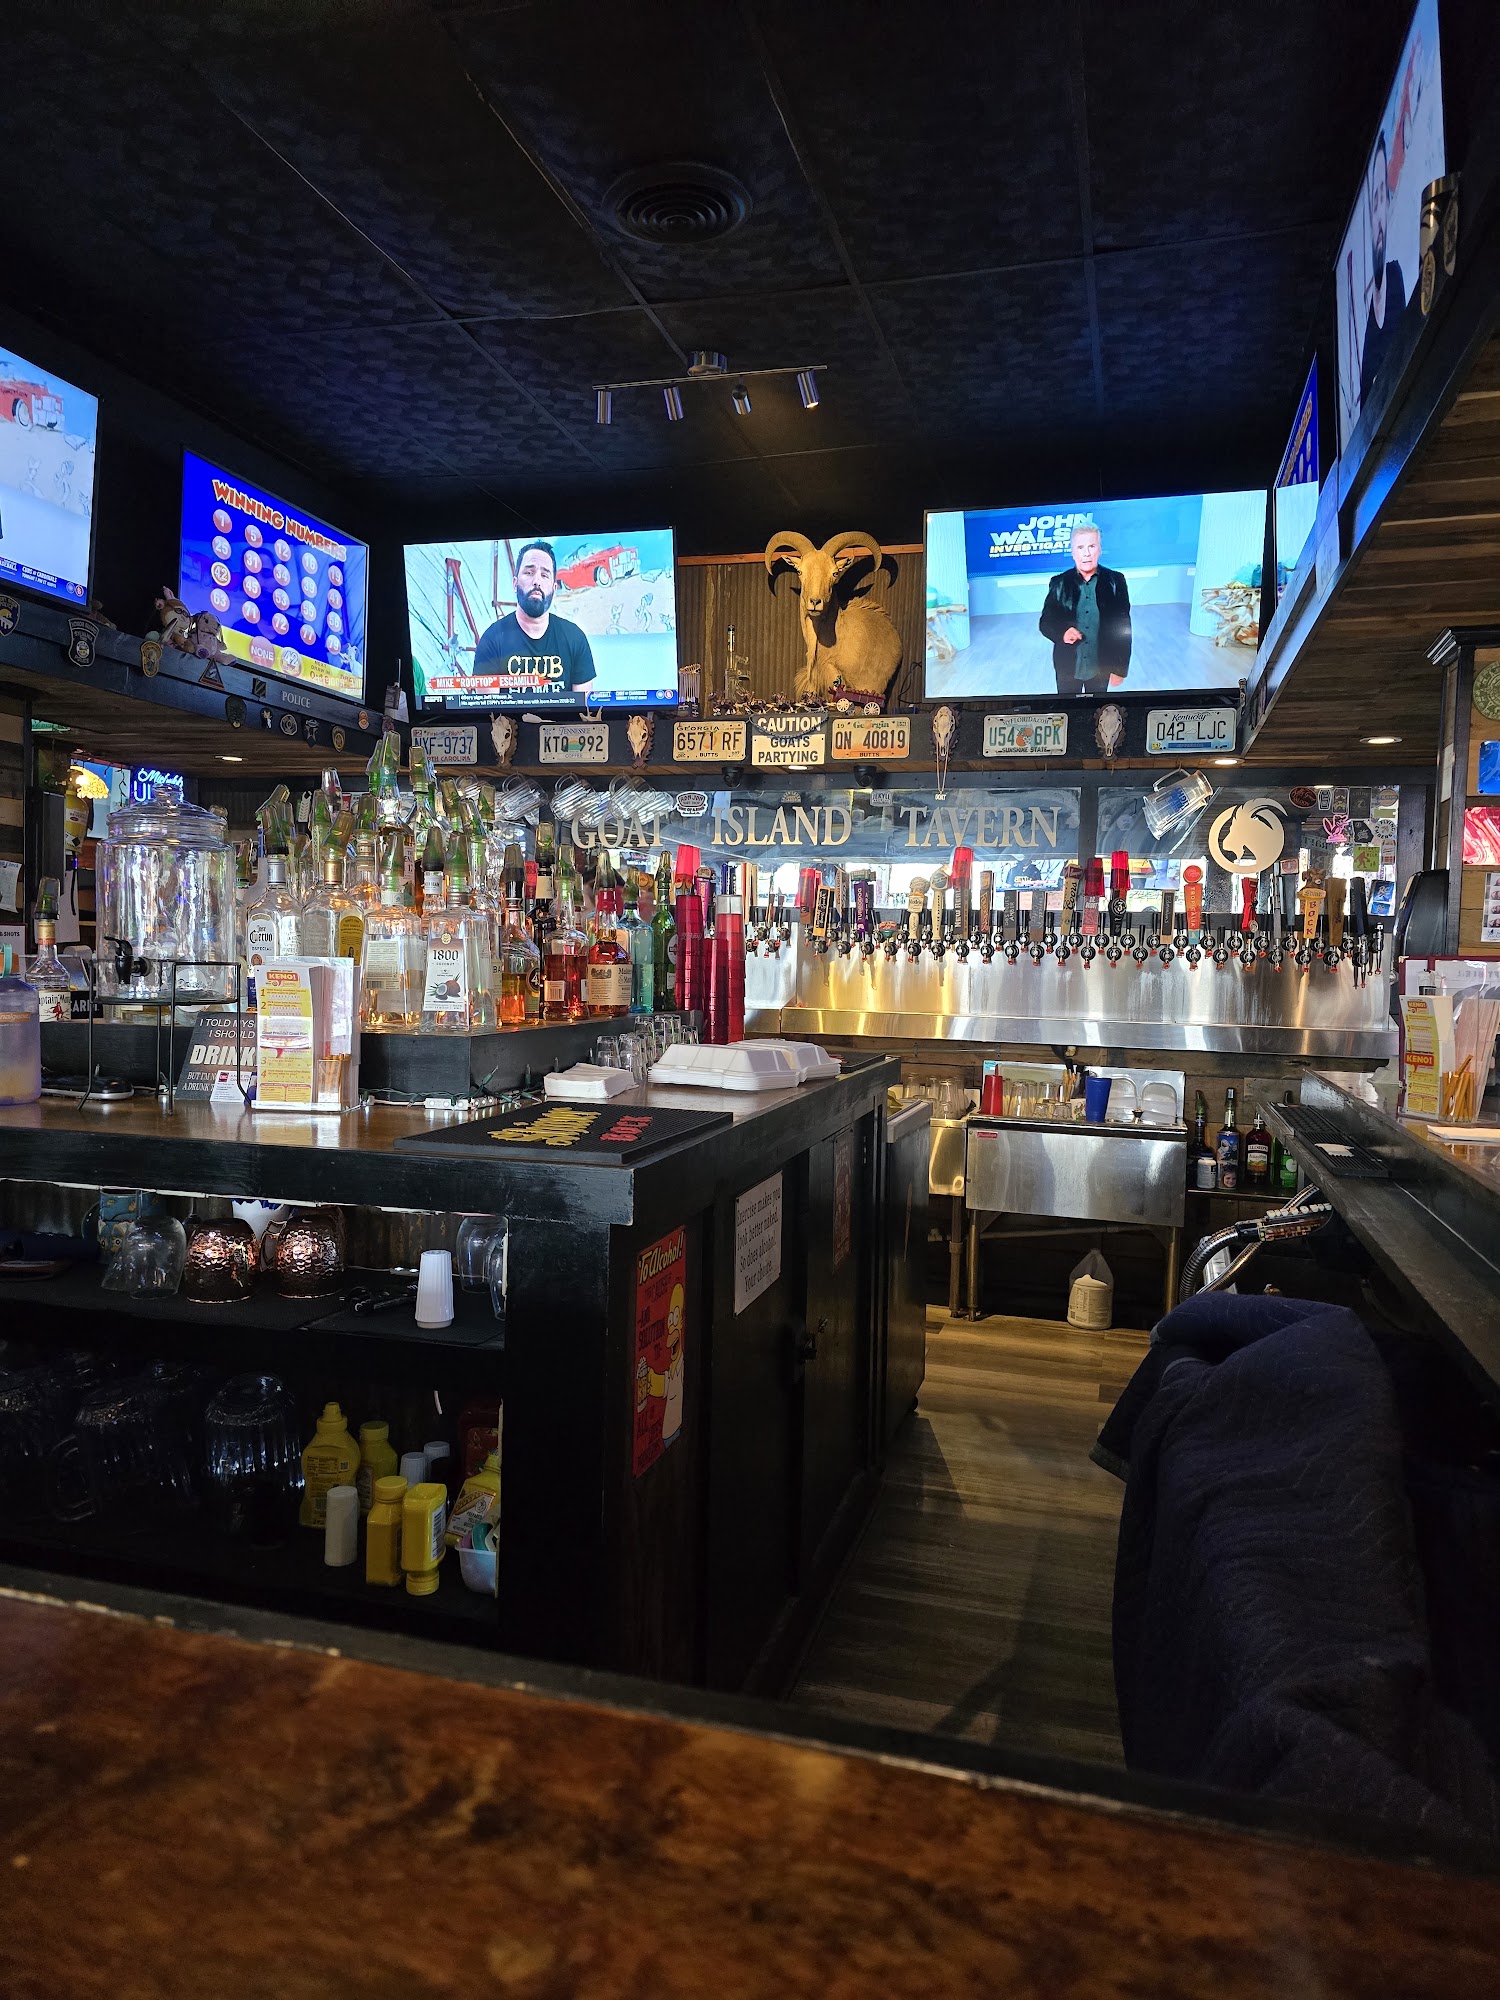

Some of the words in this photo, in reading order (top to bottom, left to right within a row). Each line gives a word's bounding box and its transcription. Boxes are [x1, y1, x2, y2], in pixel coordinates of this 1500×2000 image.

[212, 479, 284, 530] WINNING
[285, 515, 347, 562] NUMBERS
[1018, 513, 1094, 530] JOHN
[276, 545, 289, 558] 12
[304, 558, 316, 570] 16
[330, 570, 342, 582] 19
[216, 542, 228, 554] 25
[246, 556, 258, 569] 31
[275, 570, 288, 582] 34
[302, 582, 315, 594] 39
[329, 594, 341, 605] 41
[214, 567, 228, 580] 42
[245, 581, 259, 594] 45
[274, 594, 288, 606] 53
[302, 606, 314, 617] 55
[213, 593, 227, 607] 63
[246, 605, 256, 619] 71
[274, 618, 287, 631] 72
[302, 630, 314, 641] 77
[328, 640, 339, 650] 79
[250, 645, 274, 661] NONE
[284, 650, 299, 666] 42
[508, 656, 564, 678] CLUB
[436, 678, 454, 688] MIKE
[456, 676, 498, 687] "ROOFTOP"
[500, 676, 540, 686] ESCAMILLA
[282, 690, 311, 708] POLICE
[758, 716, 822, 732] CAUTION
[1172, 713, 1207, 722] Kentucky
[558, 726, 591, 735] TENNESSEE
[863, 730, 906, 749] 40819
[989, 727, 1014, 746] U54
[1034, 726, 1062, 746] 6PK
[1156, 722, 1184, 740] 042
[1197, 721, 1226, 740] LJC
[415, 736, 474, 755] NXF-9737
[544, 737, 569, 751] KTQ
[580, 736, 604, 751] 992
[677, 732, 713, 751] 6571
[723, 732, 742, 750] RF
[770, 736, 810, 748] GOATS
[758, 750, 818, 763] PARTYING
[711, 806, 852, 846] ISLAND
[900, 806, 1062, 848] TAVERN
[1066, 882, 1077, 910] Coors
[1307, 901, 1316, 935] BOCK
[433, 950, 459, 961] 1800
[40, 994, 58, 1006] ptain
[261, 989, 266, 997] 1
[1406, 1055, 1433, 1064] KENO!
[261, 1070, 266, 1078] 4
[187, 1083, 209, 1091] DRUNK
[600, 1116, 653, 1142] BOCK
[738, 1203, 756, 1227] Exercise
[758, 1192, 772, 1212] makes
[773, 1188, 781, 1207] you
[737, 1228, 748, 1251] look
[749, 1224, 763, 1242] better
[764, 1206, 778, 1230] naked.
[639, 1250, 652, 1285] To
[650, 1230, 684, 1278] Alcohol!
[741, 1256, 746, 1272] So
[748, 1249, 758, 1266] does
[760, 1230, 776, 1258] alcohol.
[745, 1273, 756, 1292] Your
